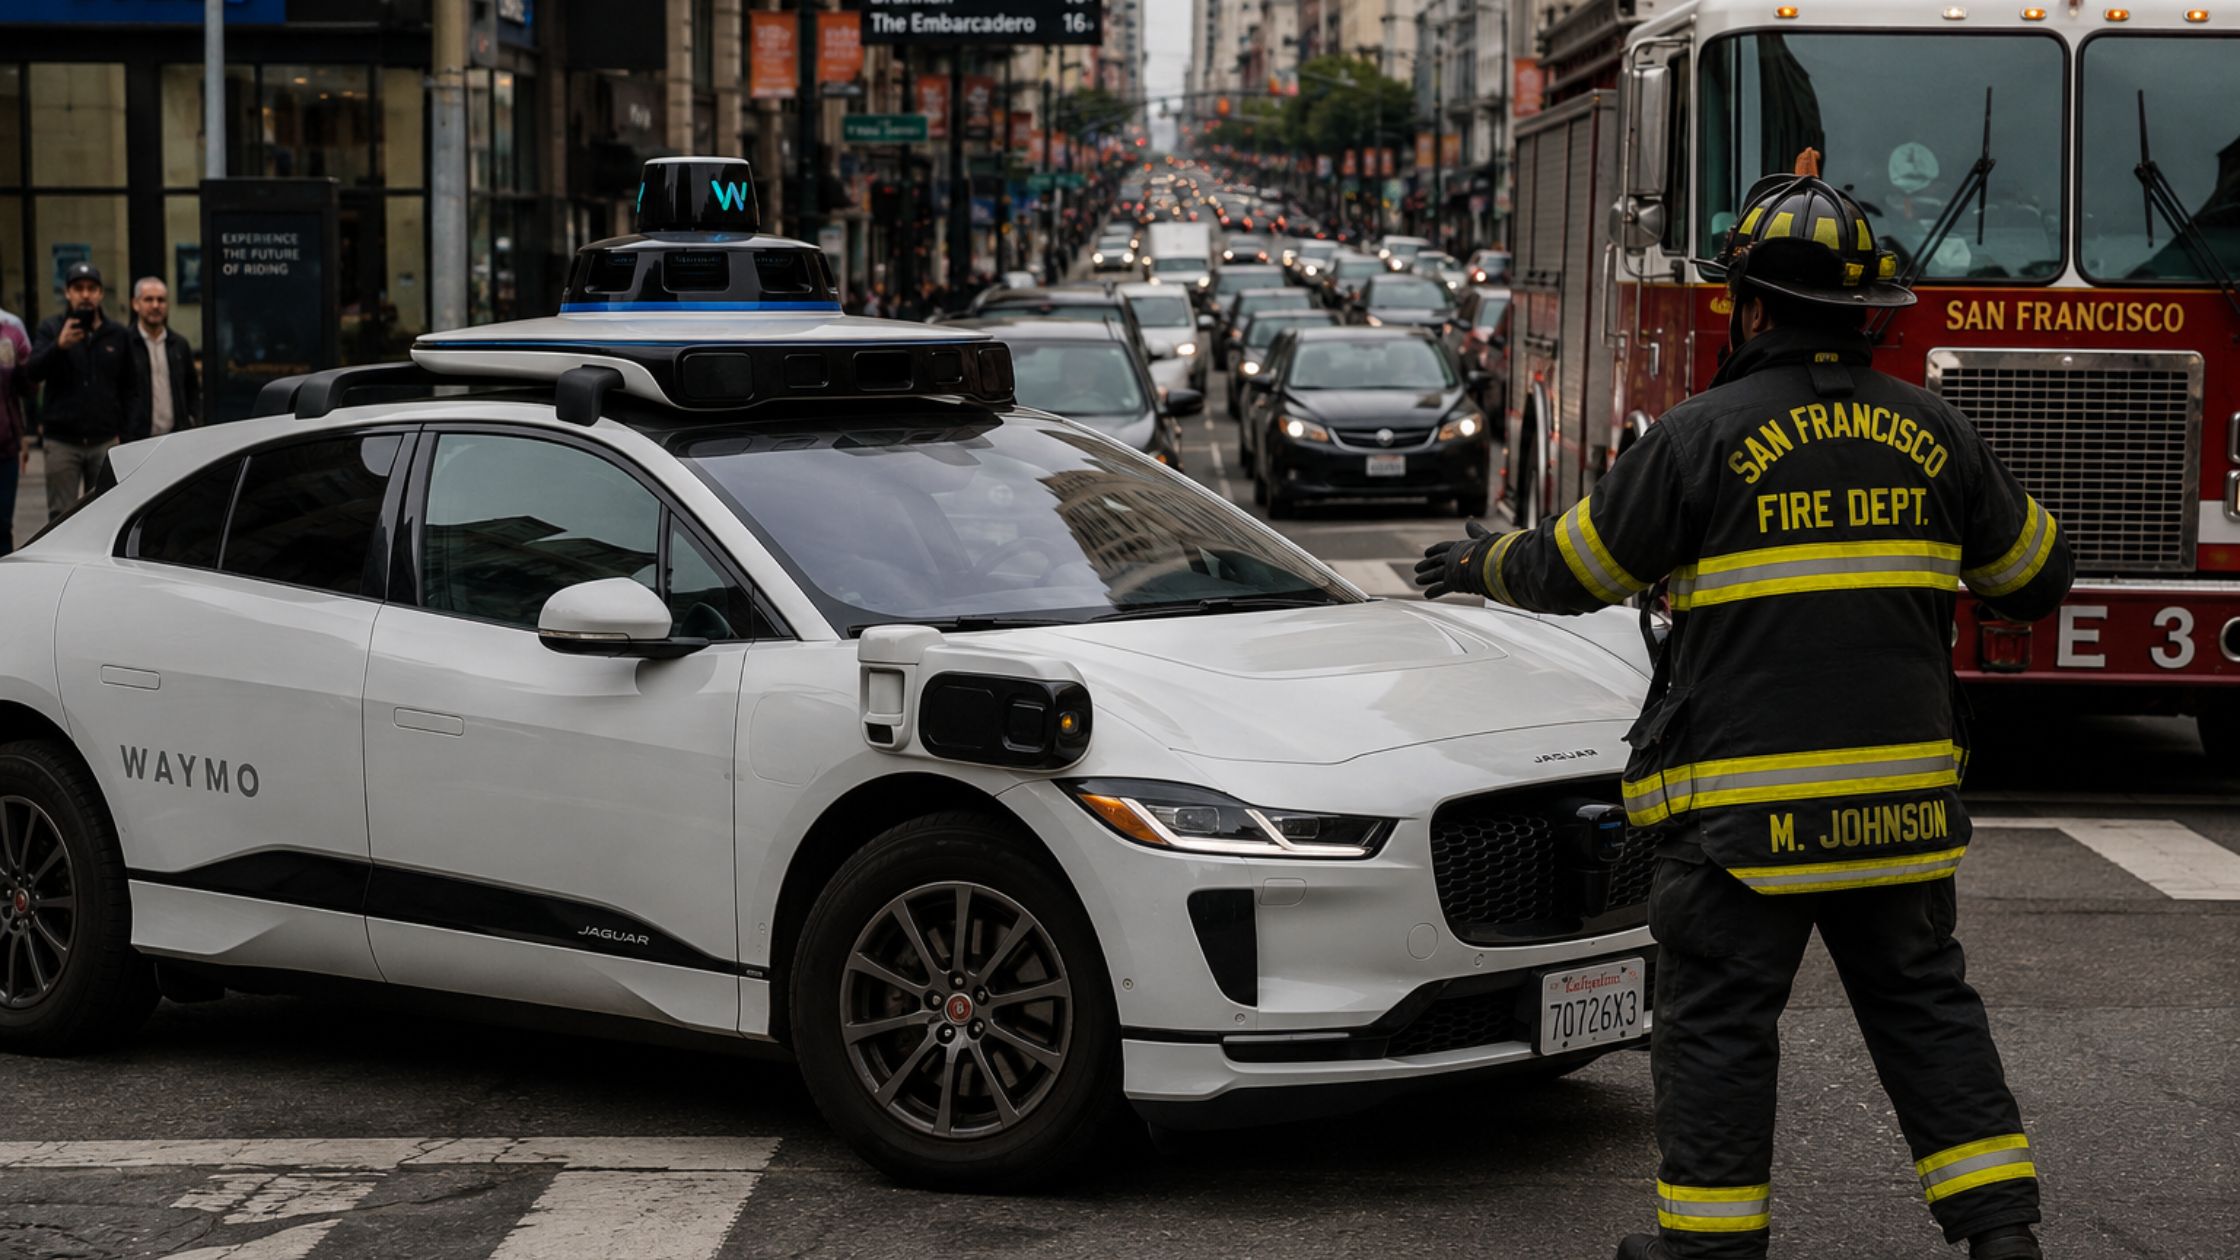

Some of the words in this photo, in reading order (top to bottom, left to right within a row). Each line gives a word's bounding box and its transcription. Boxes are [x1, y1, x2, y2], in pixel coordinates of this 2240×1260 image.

[870, 13, 907, 33] The
[911, 13, 1036, 33] Embarcadero
[222, 232, 299, 245] EXPERIENCE
[223, 248, 246, 259] THE
[250, 248, 300, 260] FUTURE
[222, 262, 240, 275] OF
[244, 262, 289, 275] RIDING
[1946, 300, 2005, 330] SAN
[2016, 301, 2184, 332] FRANCISCO
[1728, 419, 1794, 484] SAN
[1789, 402, 1948, 478] FRANCISCO
[1757, 490, 1834, 533] FIRE
[1847, 487, 1929, 527] DEPT.
[2057, 605, 2108, 667] E
[2150, 606, 2195, 669] 3
[120, 744, 259, 798] WAYMO
[1534, 748, 1598, 764] JAGUAR
[1769, 813, 1806, 853] M.
[1819, 800, 1948, 849] JOHNSON
[577, 925, 650, 946] JAGUAR
[1550, 989, 1637, 1041] 70726X3
